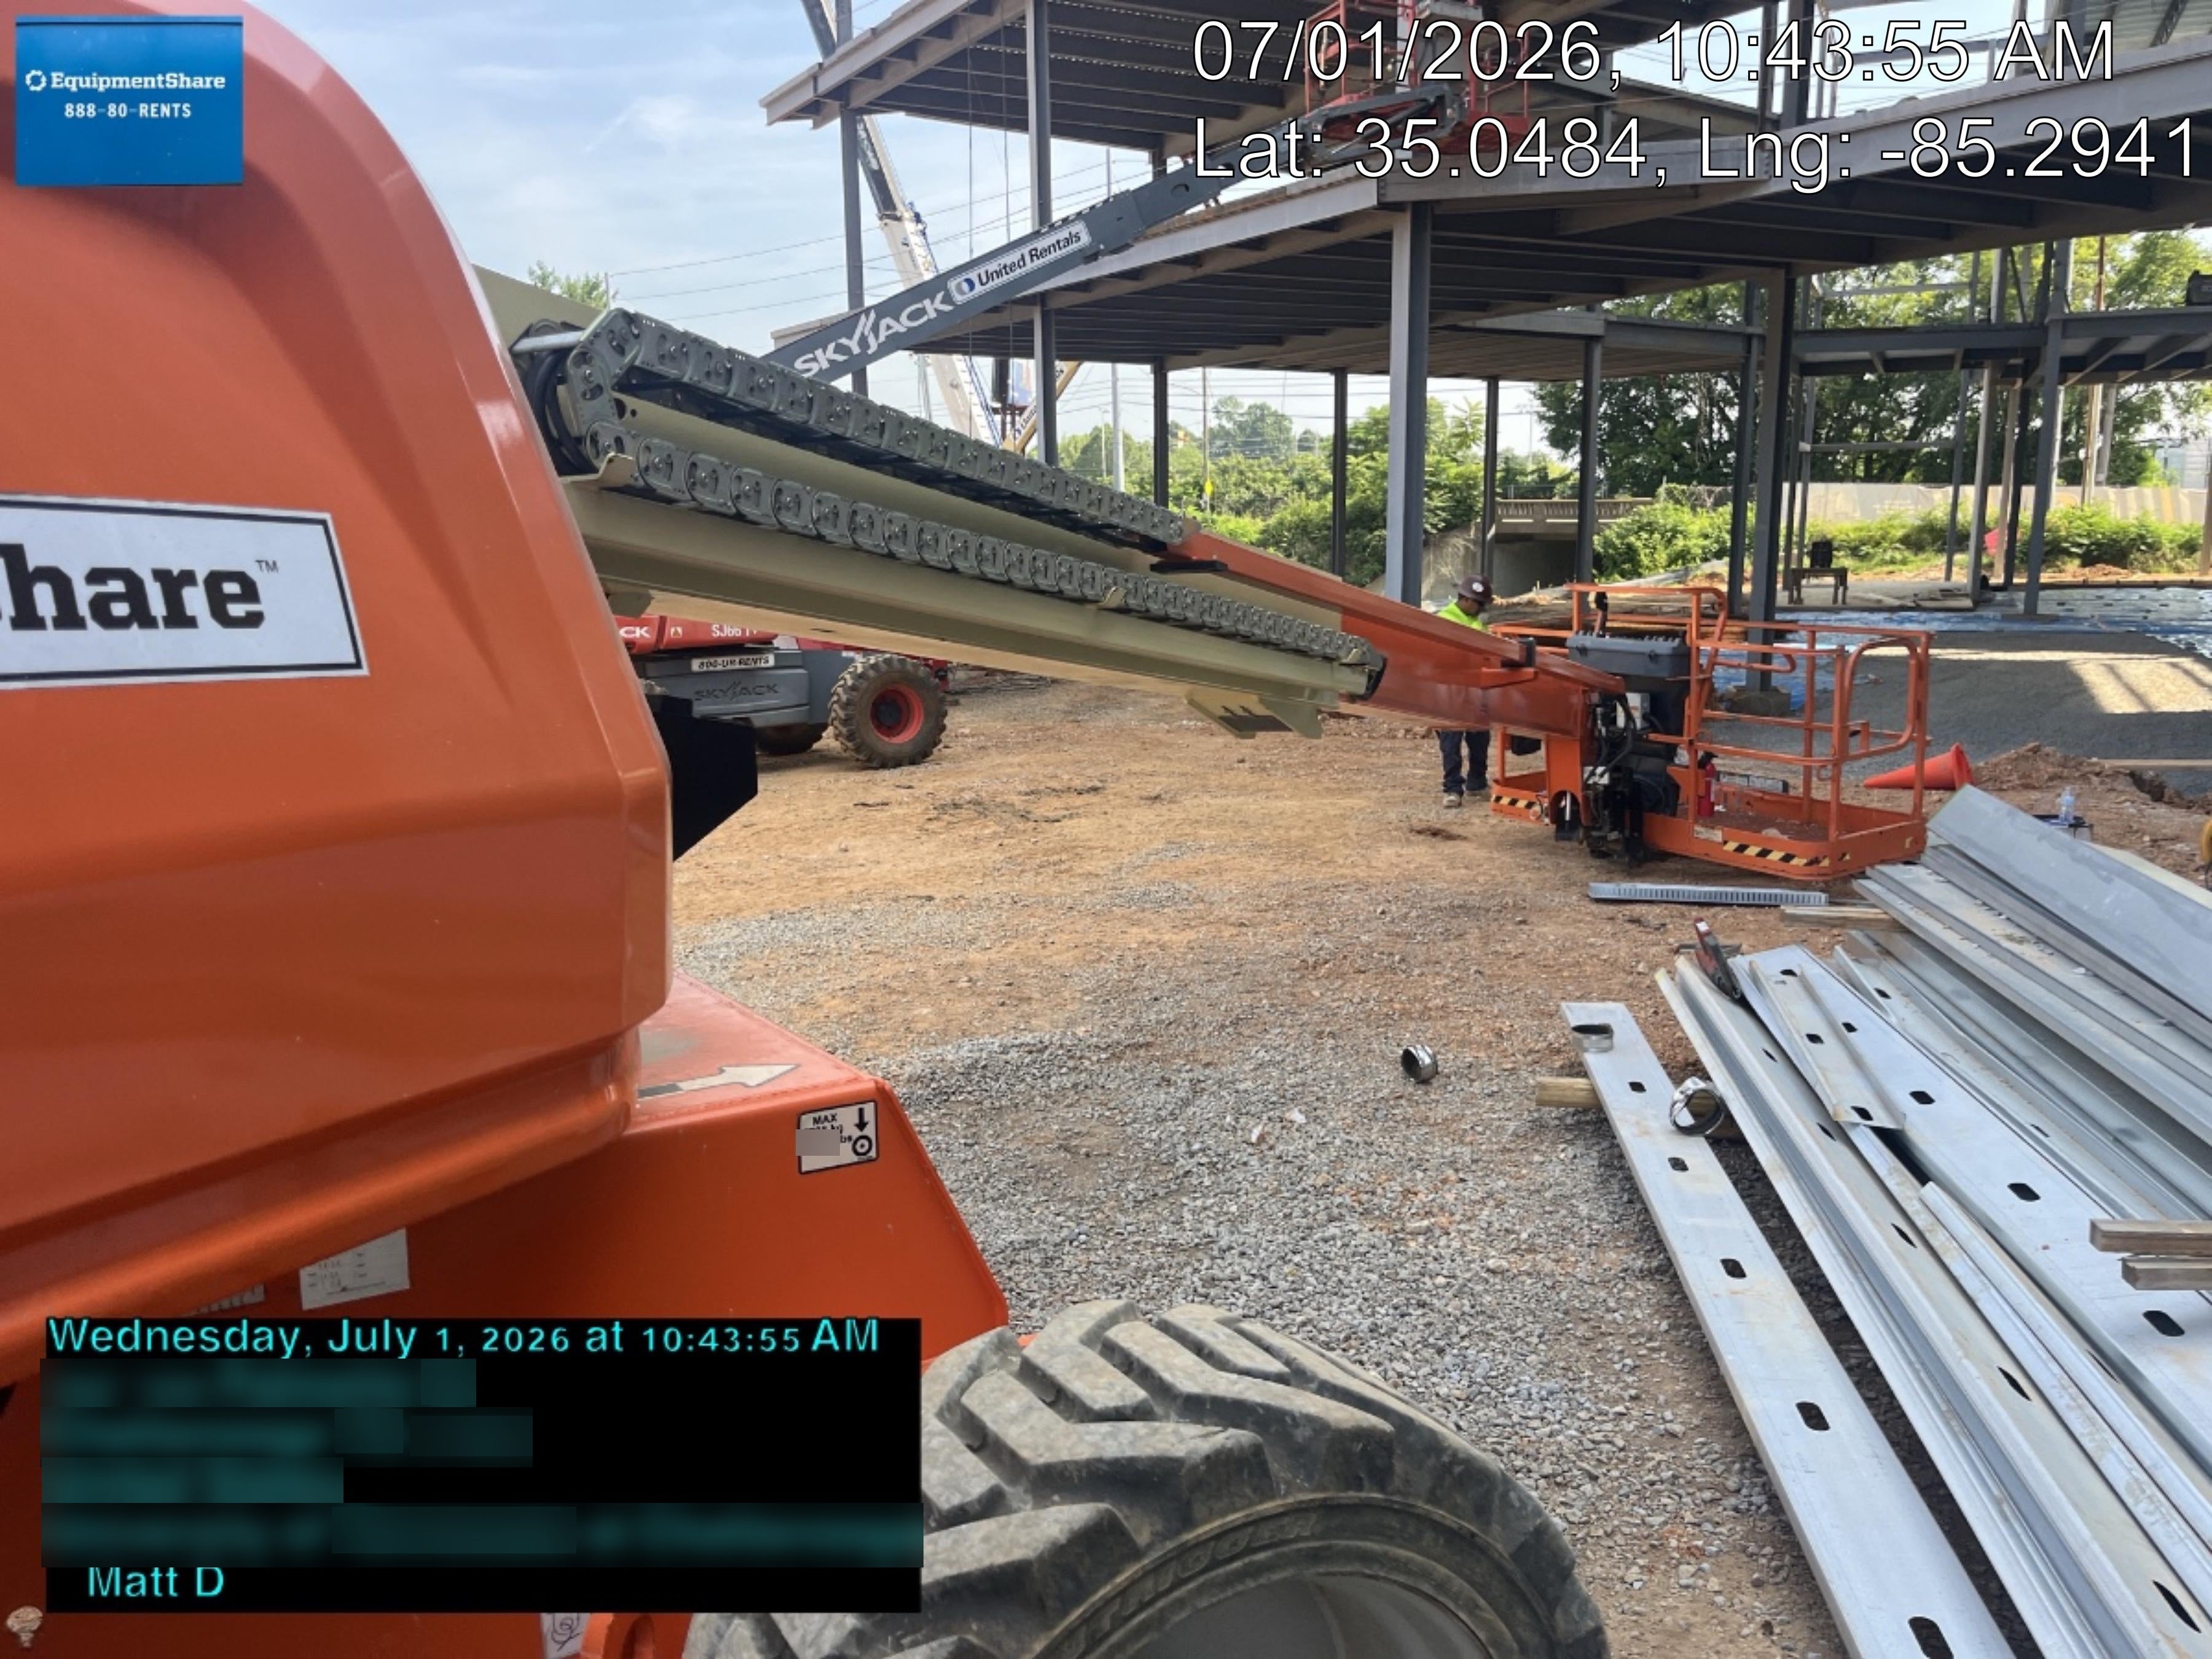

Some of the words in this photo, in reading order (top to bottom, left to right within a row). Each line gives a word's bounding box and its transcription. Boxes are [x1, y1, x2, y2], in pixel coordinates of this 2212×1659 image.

[793, 290, 955, 379] SKYJACK
[977, 254, 1027, 288] United
[1029, 229, 1082, 264] Rentals
[0, 544, 265, 631] hare
[812, 1113, 837, 1126] MAX
